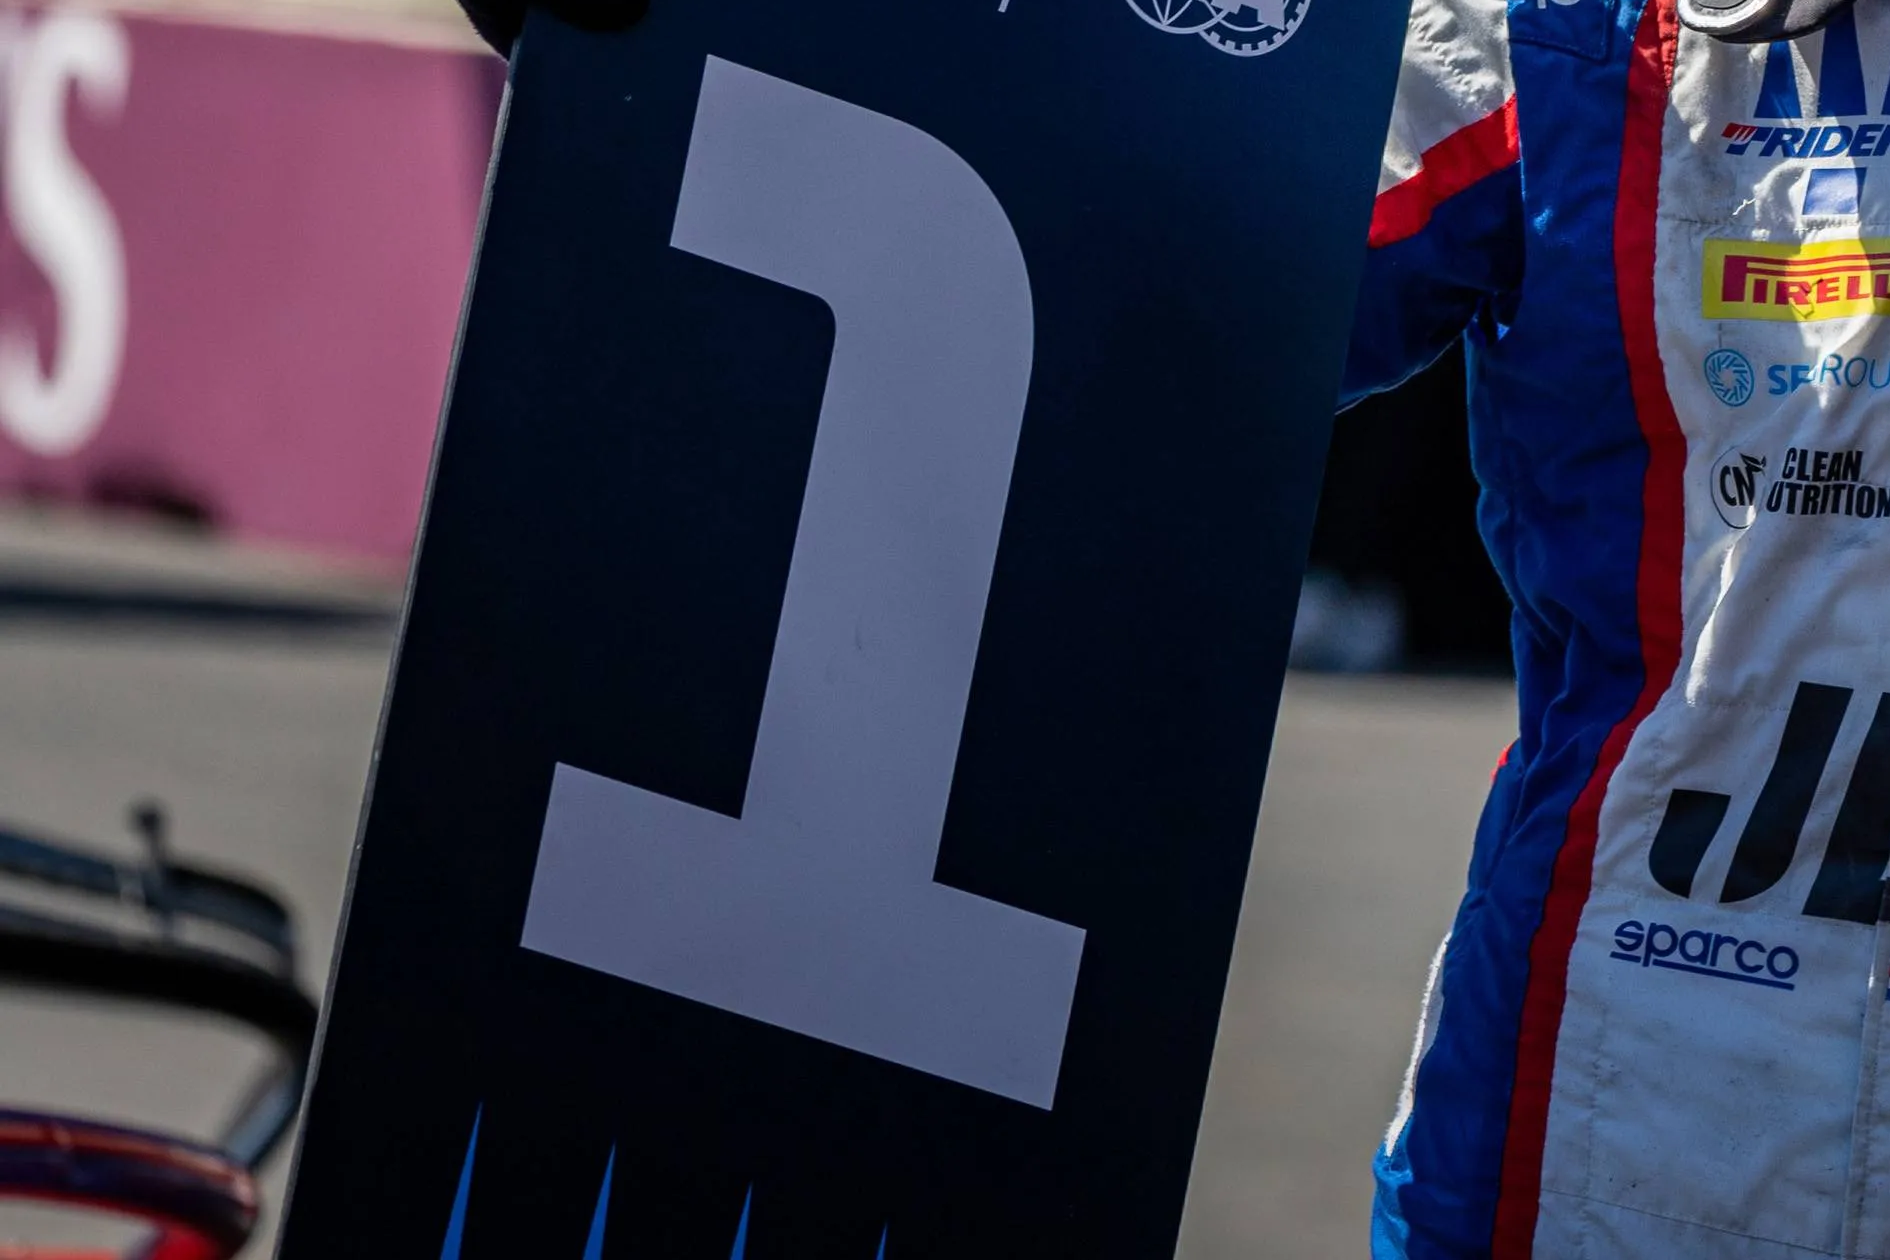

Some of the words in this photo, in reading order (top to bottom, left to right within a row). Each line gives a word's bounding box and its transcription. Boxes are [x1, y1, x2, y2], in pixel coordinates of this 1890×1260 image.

[1782, 447, 1864, 483] CLEAN
[520, 53, 1087, 1111] 1
[1609, 919, 1801, 991] sparco
